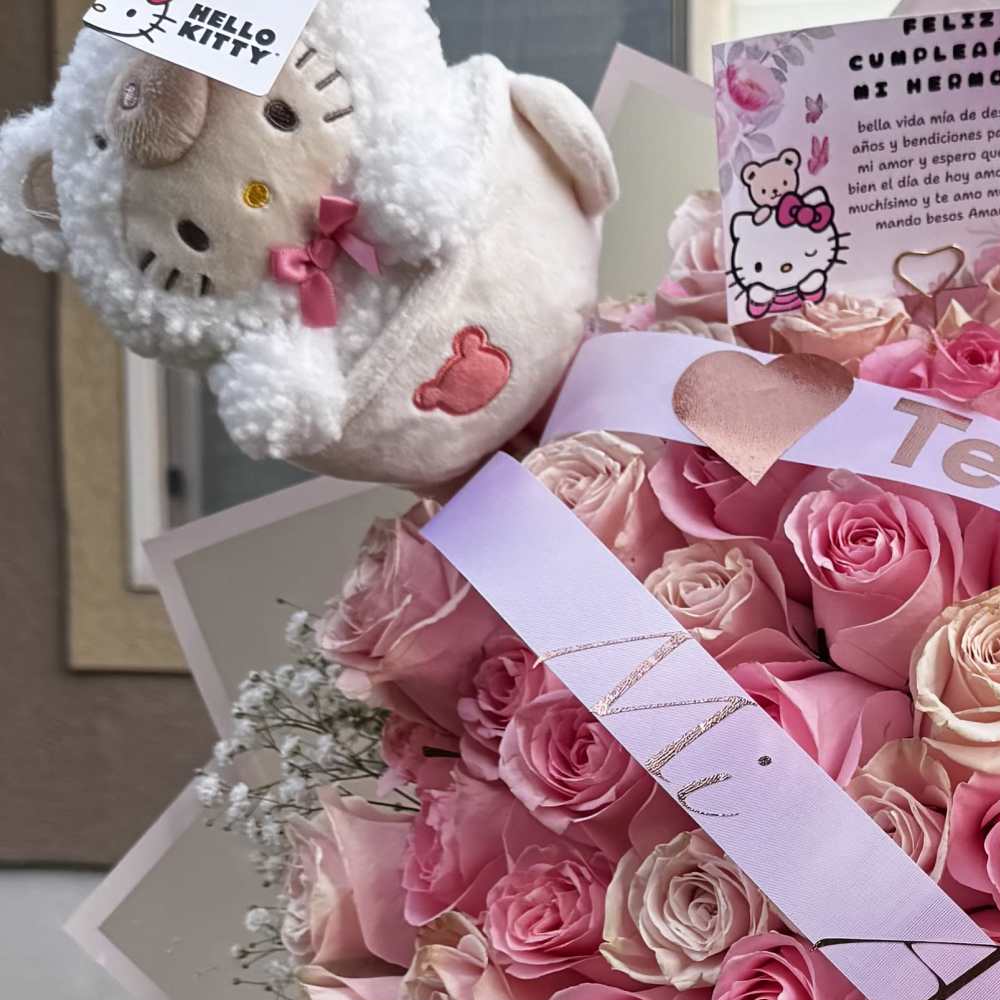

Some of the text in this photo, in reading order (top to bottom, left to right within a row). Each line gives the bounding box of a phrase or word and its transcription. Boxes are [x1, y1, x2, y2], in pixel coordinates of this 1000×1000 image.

[188, 3, 276, 46] HELLO
[903, 12, 994, 35] FELIZ
[177, 20, 272, 65] KITTY
[853, 81, 888, 100] MI
[857, 118, 892, 133] bella
[896, 114, 926, 129] vida
[929, 109, 956, 125] mía
[960, 104, 977, 121] de
[852, 140, 886, 155] años
[889, 139, 898, 154] y
[902, 130, 983, 149] bendiciones
[857, 160, 875, 174] mi
[878, 158, 915, 171] amor
[919, 156, 928, 170] y
[931, 151, 977, 167] espero
[847, 181, 877, 196] bien
[881, 177, 894, 191] el
[897, 175, 920, 189] día
[923, 172, 941, 186] de
[944, 170, 971, 185] hoy
[848, 197, 919, 215] muchísimo
[922, 195, 931, 209] y
[935, 192, 949, 205] te
[953, 190, 983, 203] amo
[875, 214, 922, 231] mando
[926, 211, 966, 226] besos
[531, 631, 773, 818] Mi
